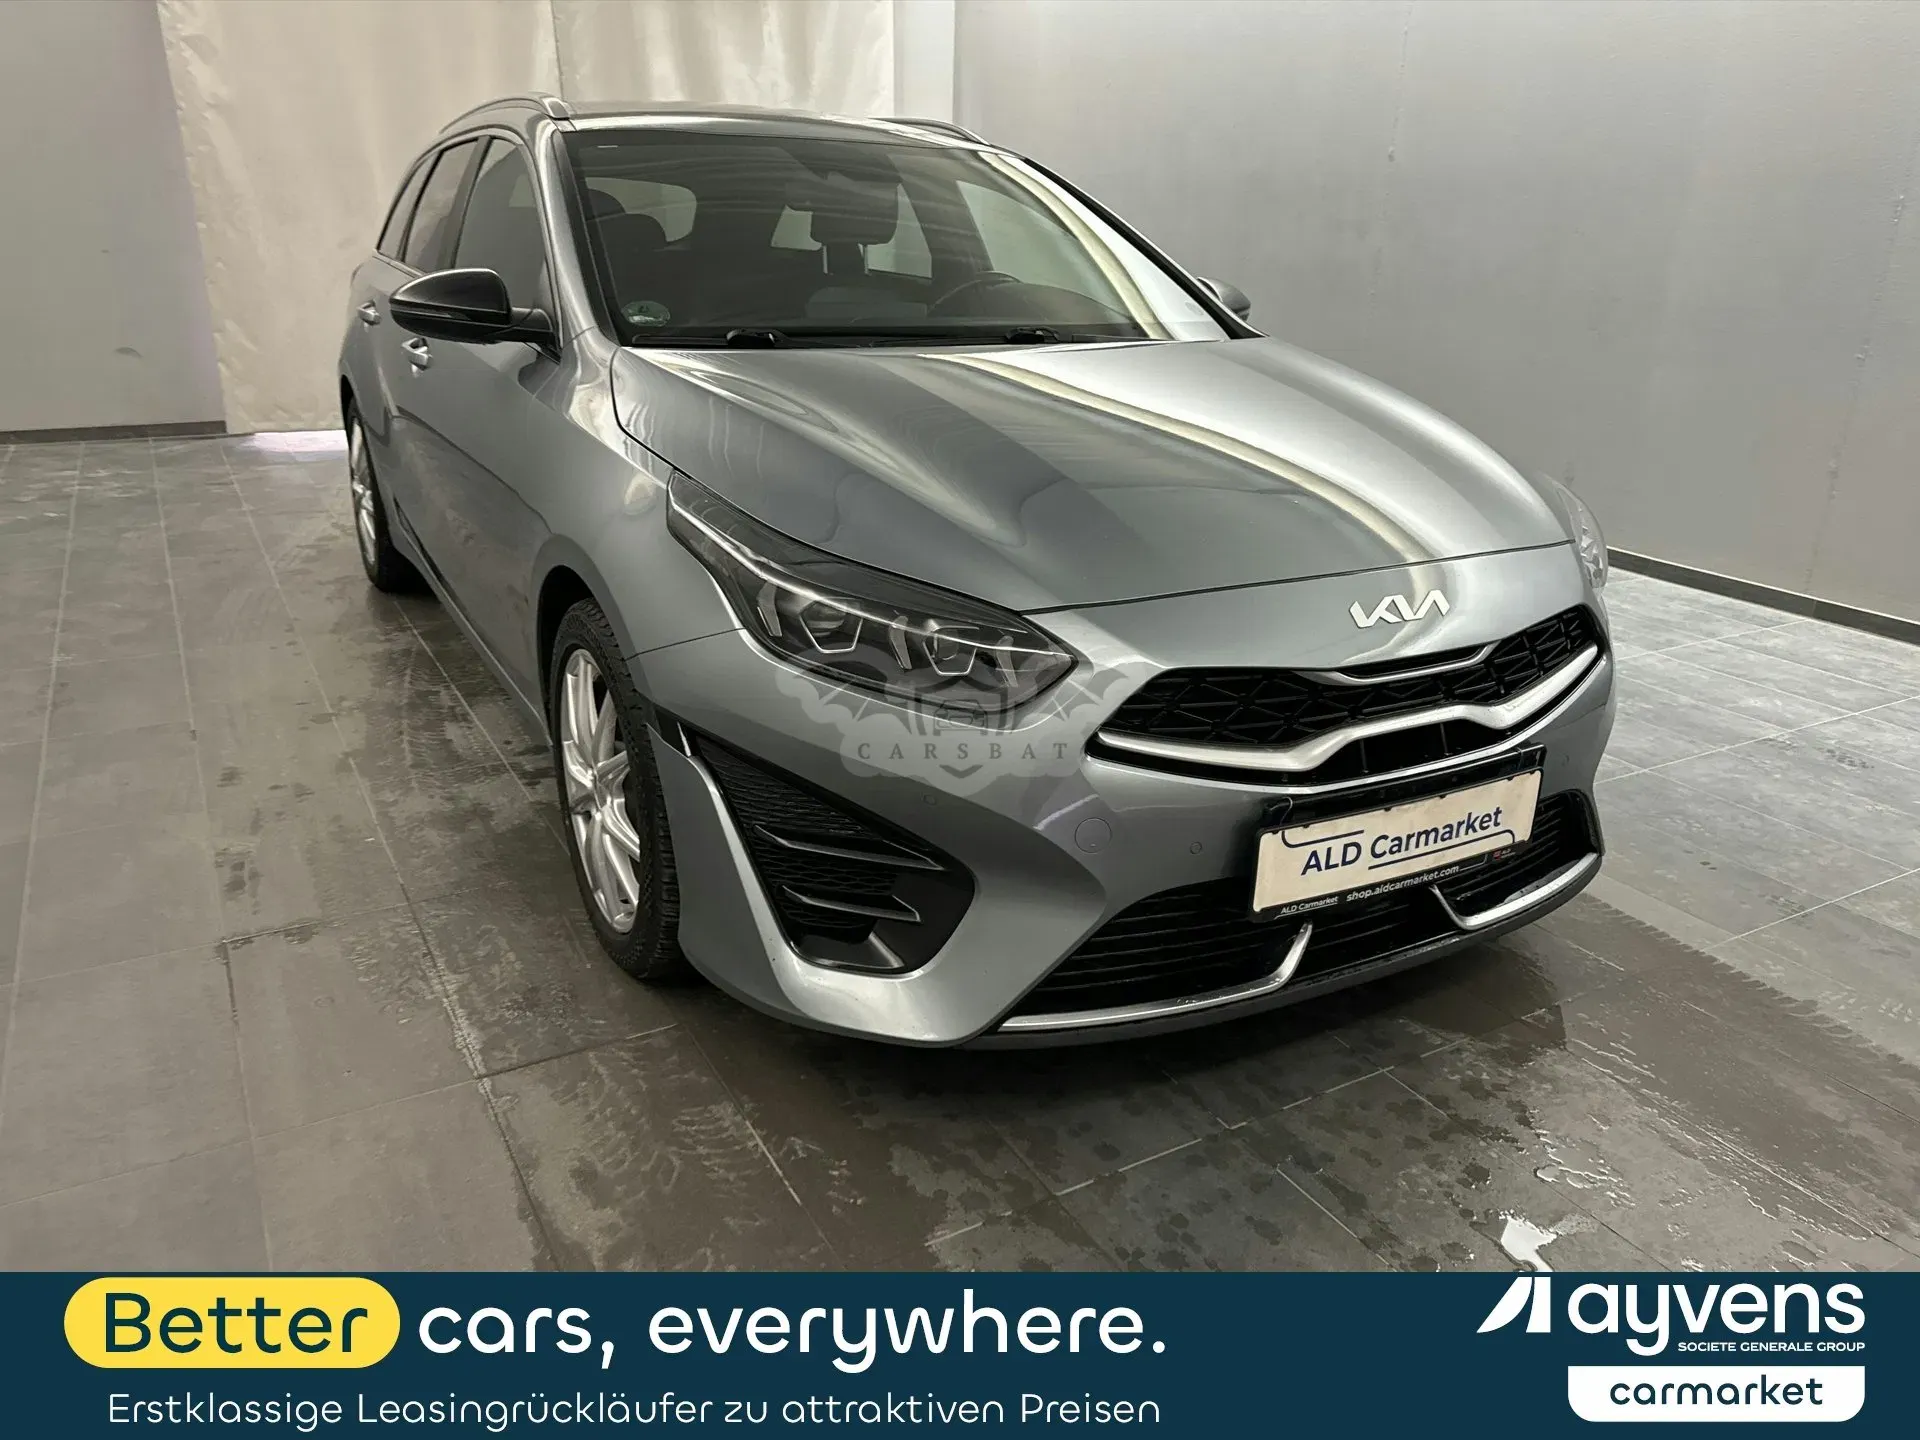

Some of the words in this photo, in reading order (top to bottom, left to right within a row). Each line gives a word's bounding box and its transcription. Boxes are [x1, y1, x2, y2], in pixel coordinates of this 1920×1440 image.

[1349, 589, 1450, 629] KIA
[1301, 841, 1362, 876] ALD
[1370, 806, 1502, 859] Carmarket
[1346, 865, 1460, 902] shop.aldcarmarket.com
[1280, 903, 1299, 914] ALD
[1298, 895, 1339, 911] Carmarket
